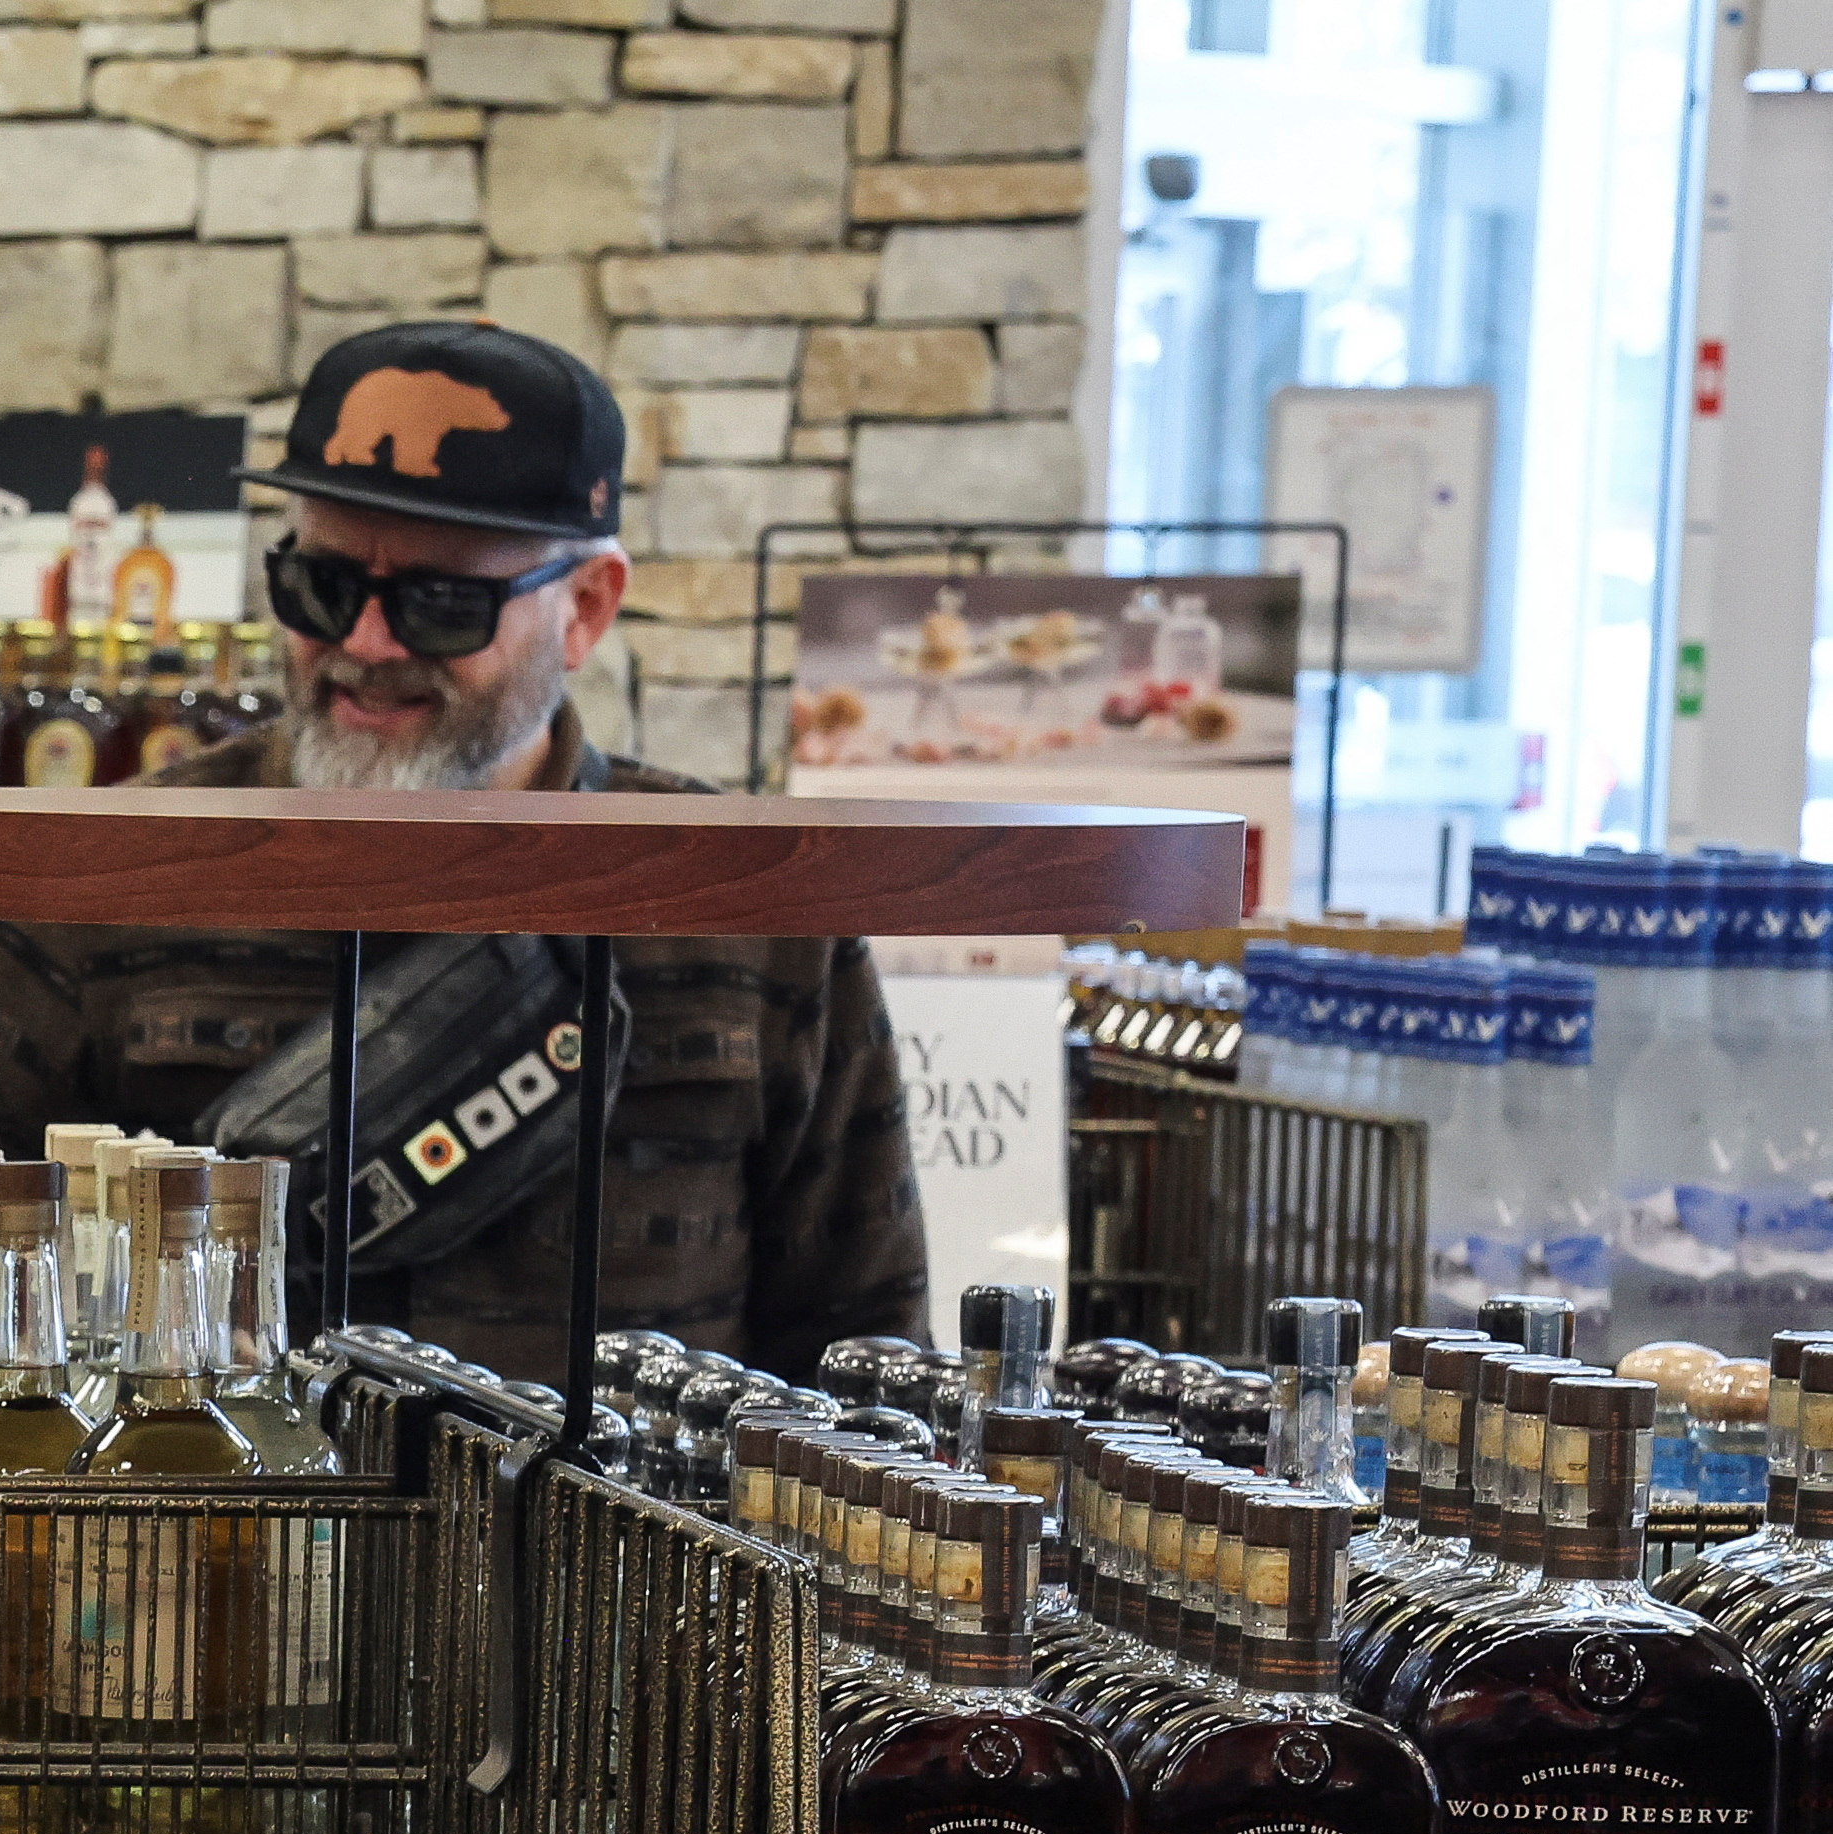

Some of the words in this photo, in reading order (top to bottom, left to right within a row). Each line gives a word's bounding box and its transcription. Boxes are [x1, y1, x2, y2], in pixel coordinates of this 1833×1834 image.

[1522, 1763, 1617, 1786] DISTILLER'S
[1624, 1765, 1679, 1790] SELECT
[1446, 1800, 1609, 1823] WOODFORD
[1620, 1805, 1749, 1825] RESERVE
